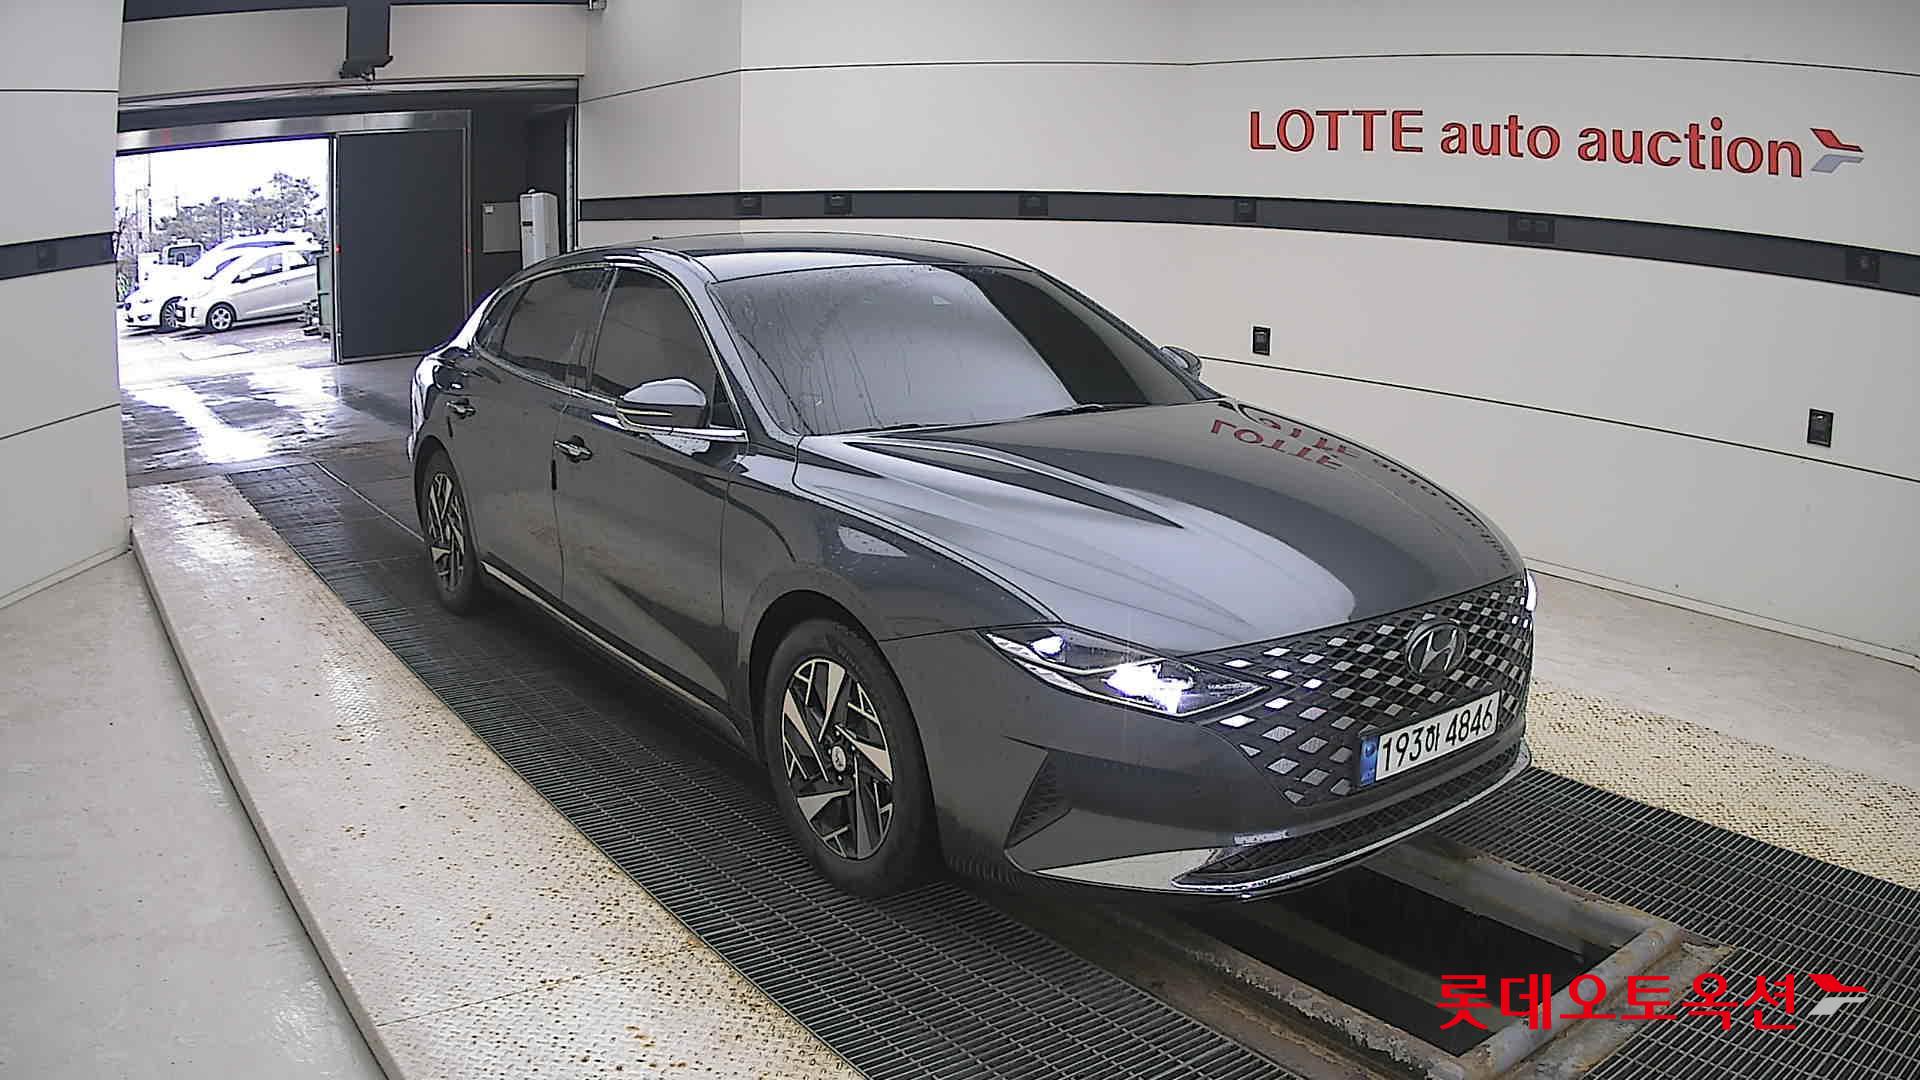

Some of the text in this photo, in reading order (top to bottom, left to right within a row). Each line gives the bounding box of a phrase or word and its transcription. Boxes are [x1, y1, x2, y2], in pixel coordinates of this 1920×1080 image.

[1248, 109, 1803, 178] LOTTE auto auction
[1382, 699, 1493, 771] 193하 4846
